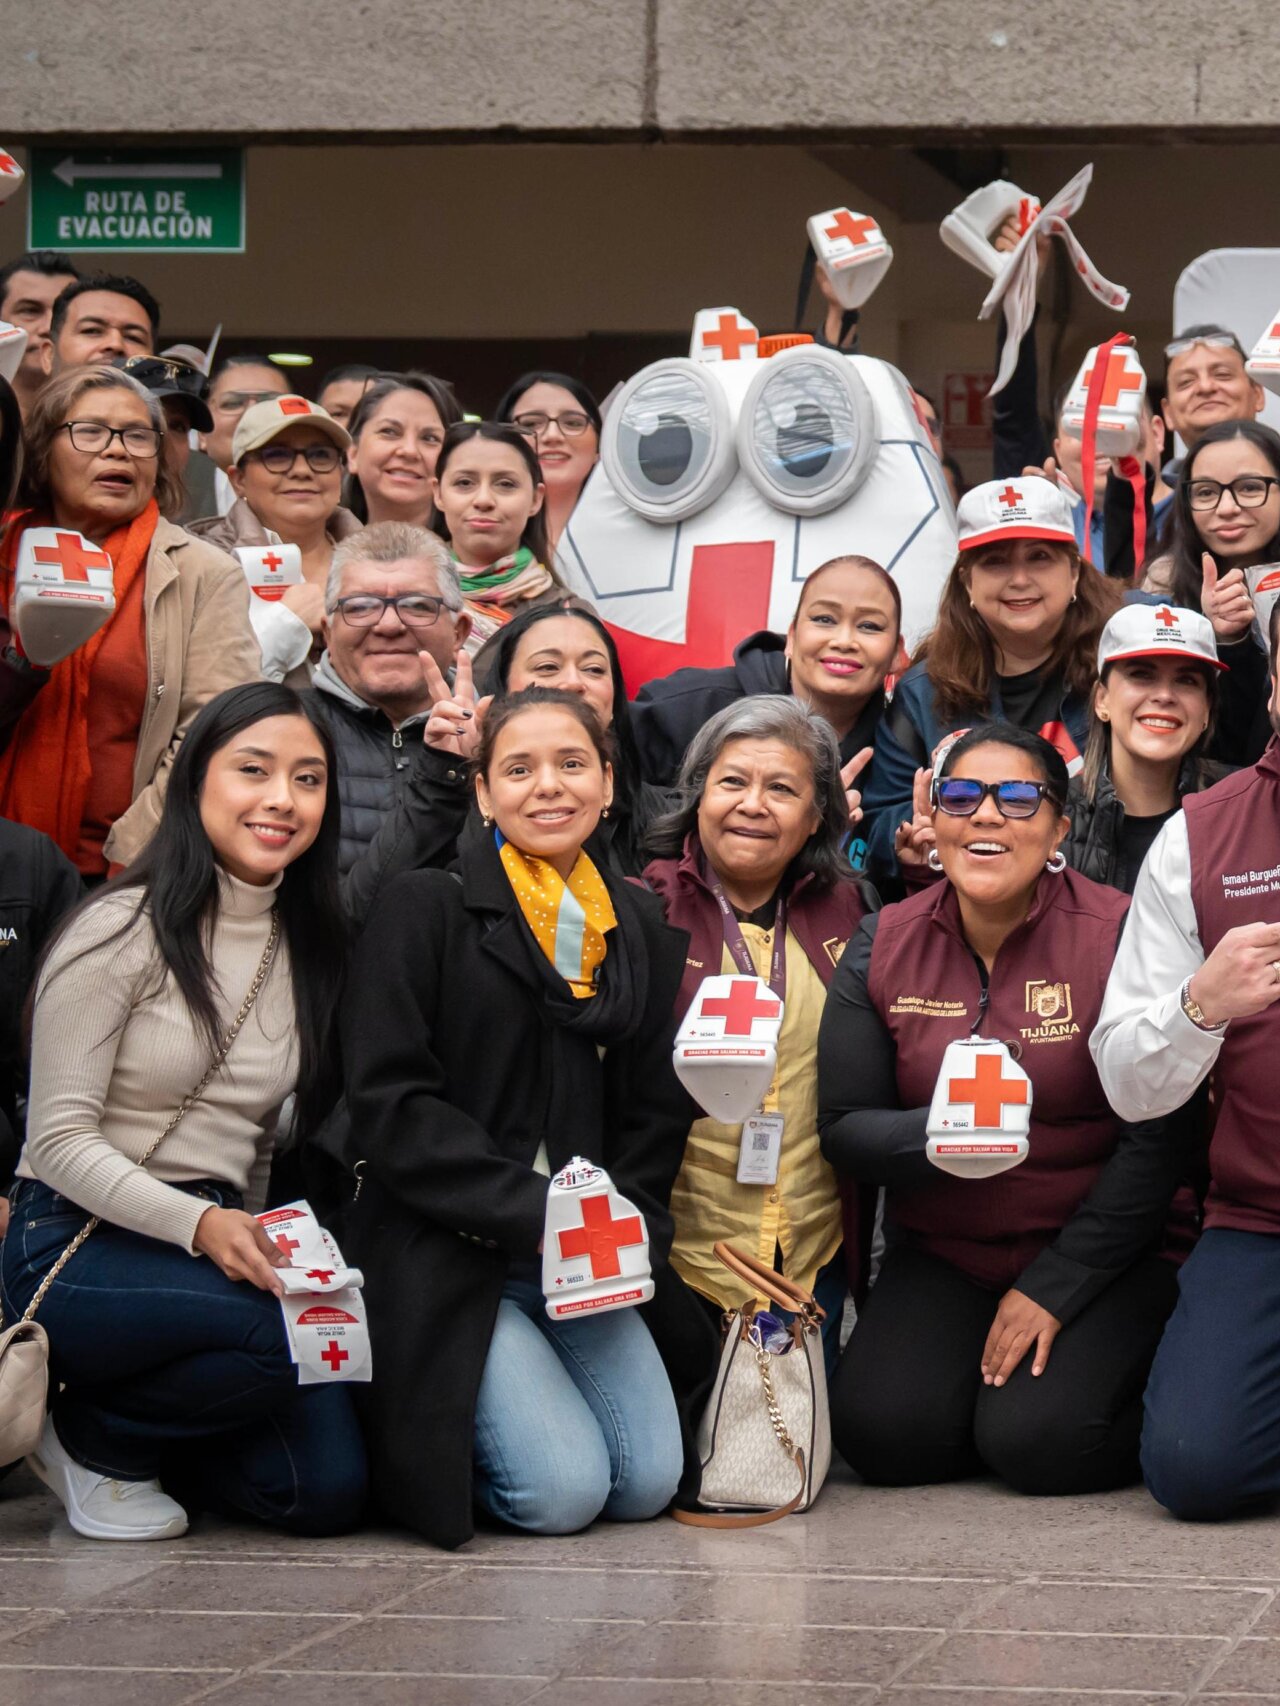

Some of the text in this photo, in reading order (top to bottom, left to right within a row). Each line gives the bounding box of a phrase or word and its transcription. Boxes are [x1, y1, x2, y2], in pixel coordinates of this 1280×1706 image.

[86, 192, 185, 213] RUTA DE
[58, 211, 213, 239] EVACUACIÓN
[1222, 872, 1248, 886] Ismael
[1224, 884, 1269, 898] Presidente
[1019, 1023, 1080, 1038] TIJUANA
[1030, 1035, 1072, 1044] AYUNTAMIENTO
[561, 1304, 582, 1313] GRACIAS
[595, 1298, 613, 1306] SALVAR
[626, 1292, 637, 1300] VIDA
